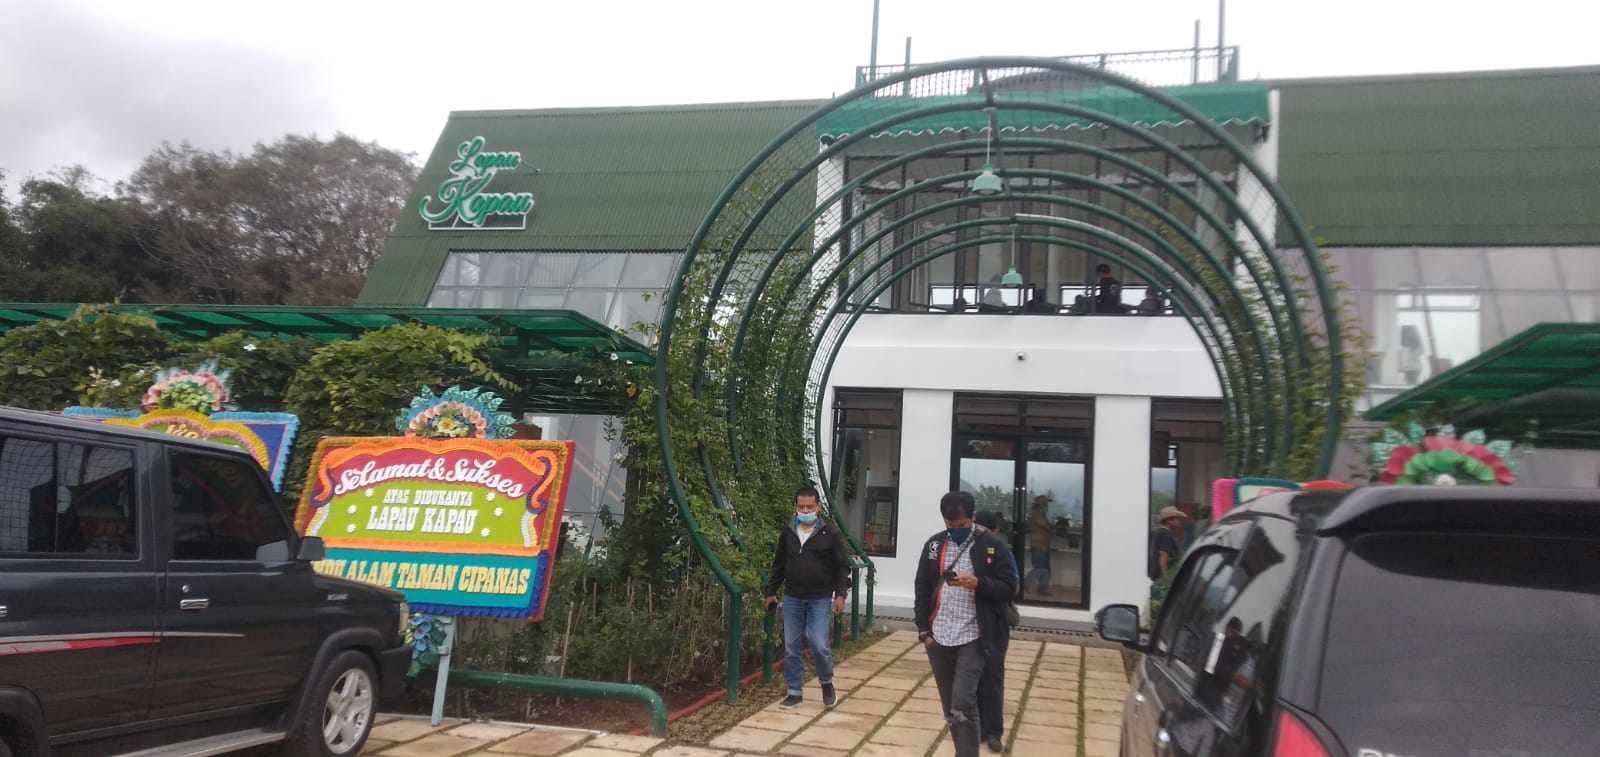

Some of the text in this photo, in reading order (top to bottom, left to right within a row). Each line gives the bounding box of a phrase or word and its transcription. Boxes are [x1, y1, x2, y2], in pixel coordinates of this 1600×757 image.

[449, 136, 521, 176] Lapau
[419, 171, 534, 227] Kapau
[334, 460, 431, 494] Selamat
[446, 459, 524, 497] Sukses
[383, 489, 472, 506] ATAS DIBUKANYA
[366, 506, 478, 534] LAPAU KAPAU
[346, 560, 397, 588] ALAM
[396, 562, 458, 591] TAMAN
[458, 567, 531, 594] CIPANAS
